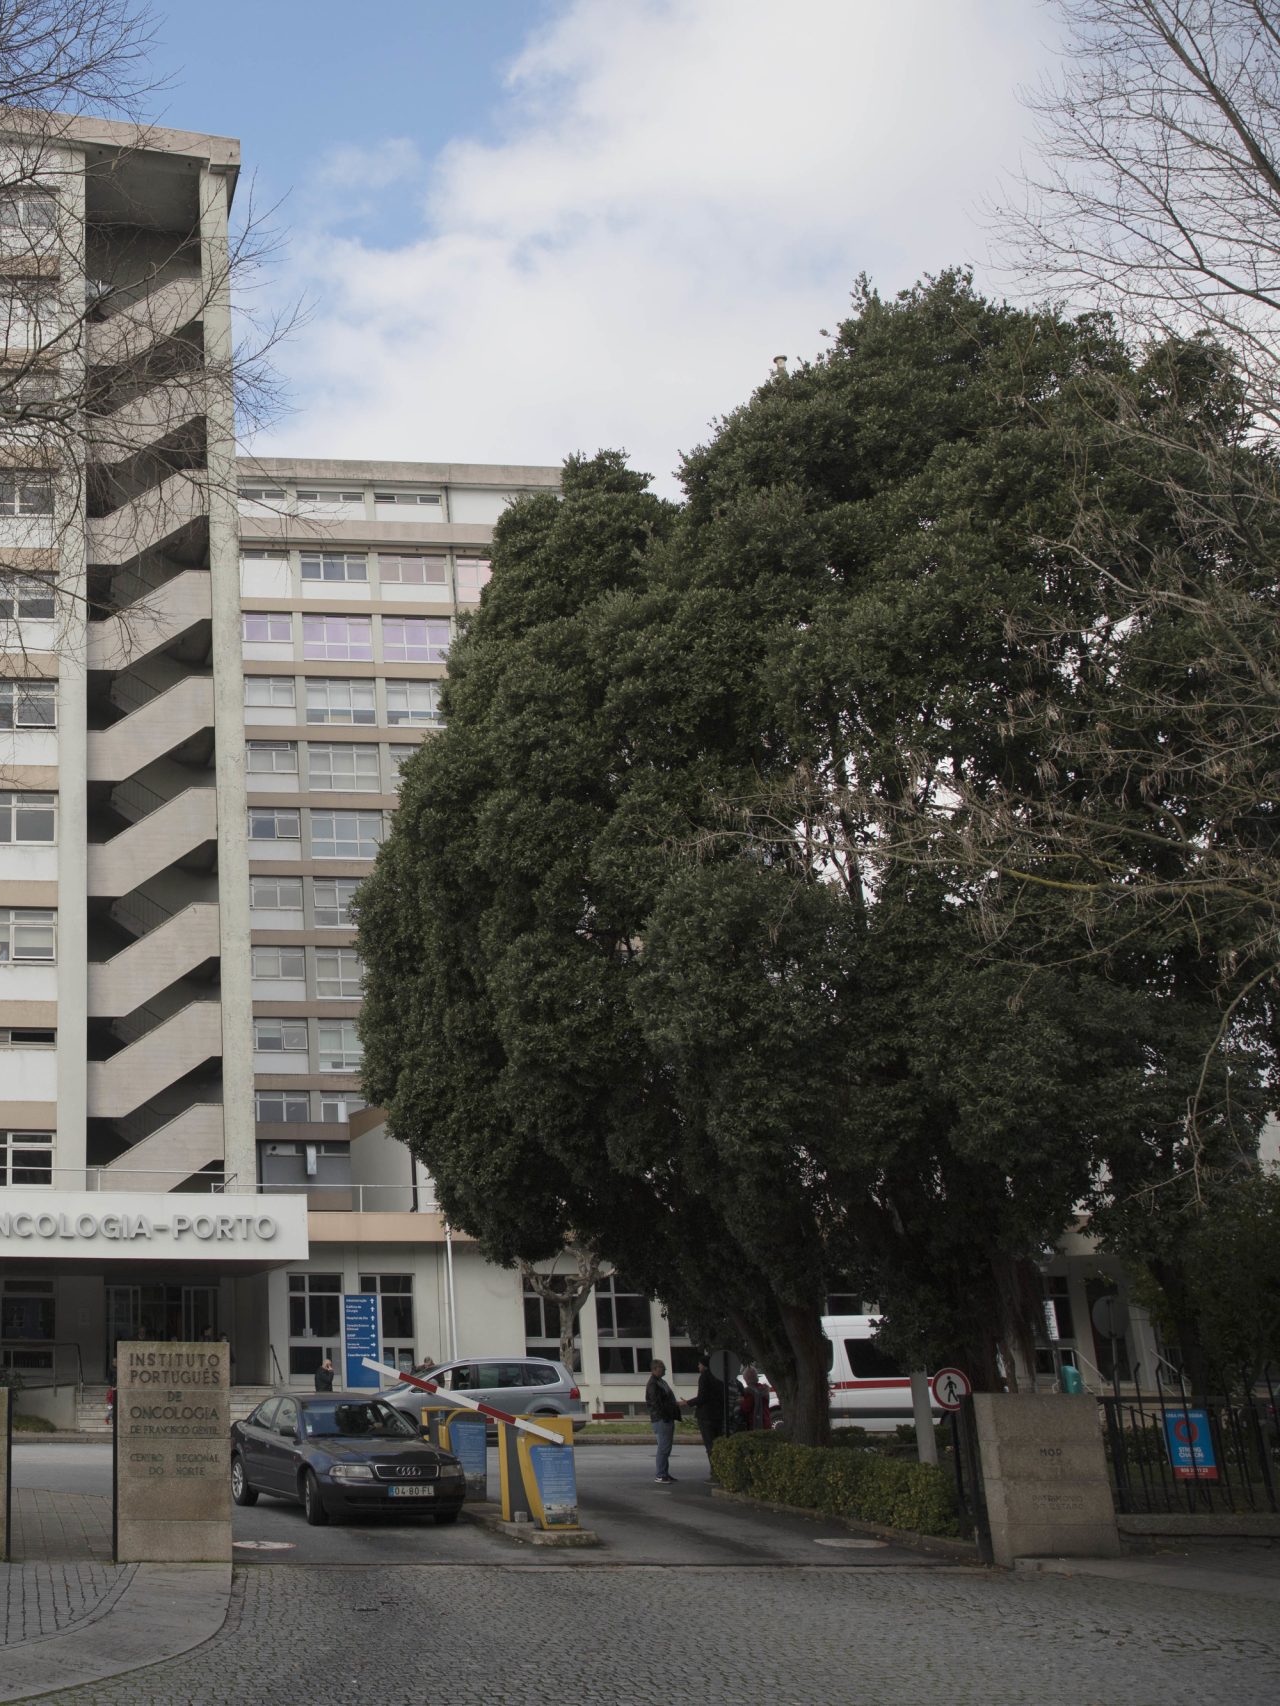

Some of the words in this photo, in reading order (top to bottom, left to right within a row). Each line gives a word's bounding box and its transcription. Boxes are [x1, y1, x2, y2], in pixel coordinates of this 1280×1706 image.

[129, 1353, 220, 1367] INSTITUTO
[167, 1391, 182, 1402] DE
[130, 1406, 220, 1420] ONCOLOGIA
[130, 1425, 141, 1434] DE
[143, 1425, 190, 1434] FRANCISCO
[192, 1426, 220, 1435] GENTIL
[130, 1453, 164, 1462] CENTRO
[175, 1454, 220, 1463] REGIONAL
[149, 1467, 164, 1475] DO
[175, 1467, 206, 1476] NORTE
